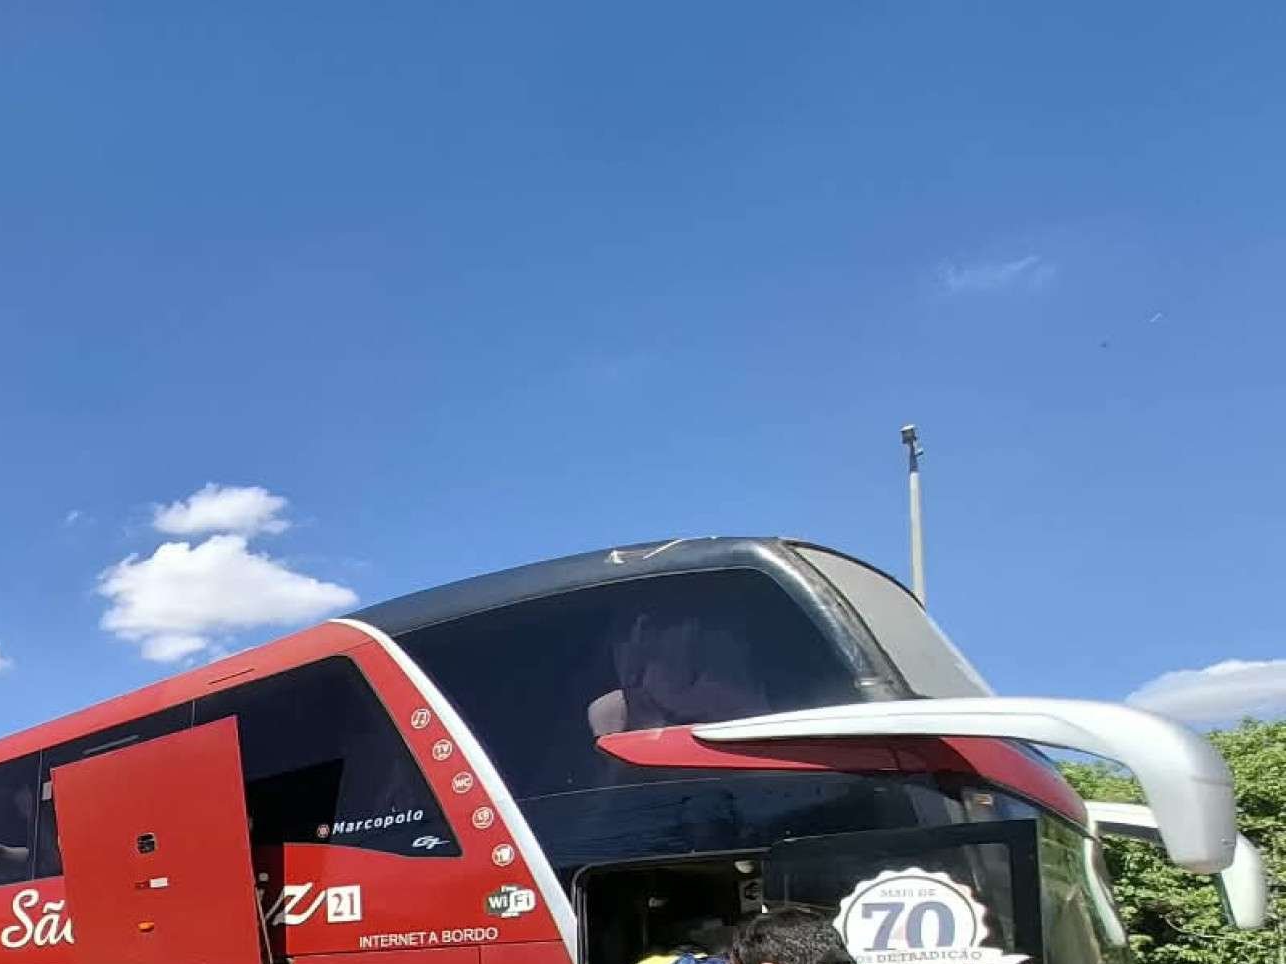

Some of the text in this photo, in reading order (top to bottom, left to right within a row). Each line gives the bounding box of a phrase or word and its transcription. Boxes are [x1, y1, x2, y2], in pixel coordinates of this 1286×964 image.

[455, 776, 471, 788] WC
[332, 809, 424, 835] Marcopolo
[332, 893, 356, 917] 21
[359, 926, 499, 948] INTERNET A BORDO
[861, 901, 956, 951] 70
